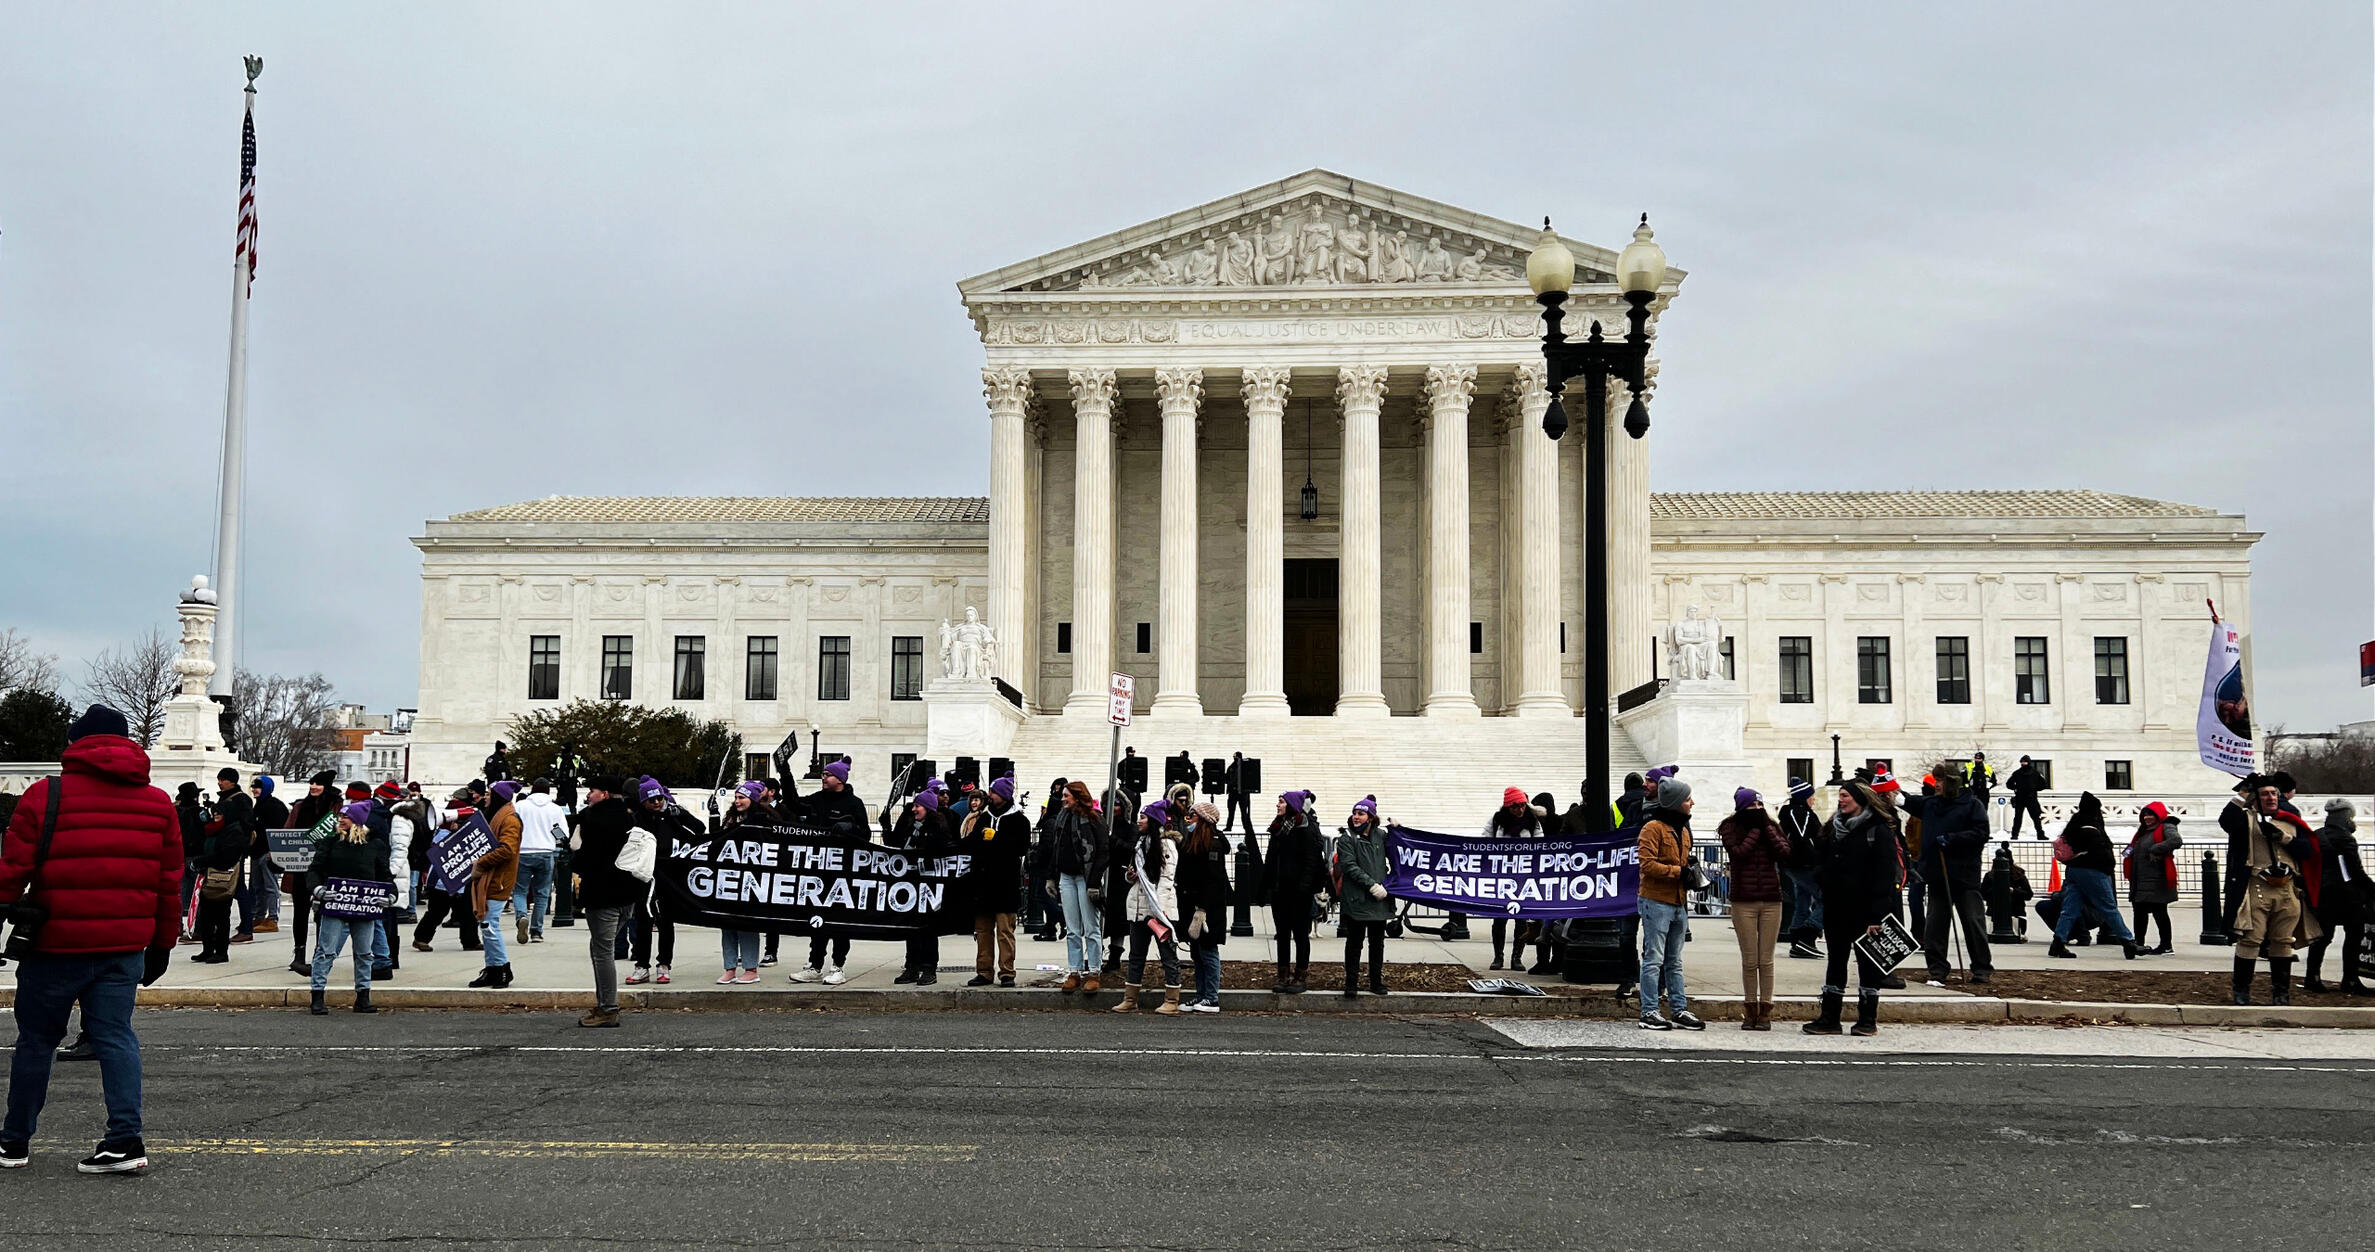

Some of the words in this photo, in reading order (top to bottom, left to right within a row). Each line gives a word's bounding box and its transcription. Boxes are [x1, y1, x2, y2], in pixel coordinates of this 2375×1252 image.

[1190, 323, 1252, 339] EQUAL
[1255, 322, 1328, 338] JUSTICE
[1336, 321, 1399, 336] UNDER
[1405, 320, 1442, 335] LAW
[442, 833, 488, 874] PRO-LIFE
[447, 843, 462, 859] AM
[462, 828, 481, 844] THE
[670, 838, 712, 861] WE
[716, 840, 779, 867] ARE
[787, 845, 844, 870] THE
[852, 849, 972, 877] PRO-LIFE
[1462, 841, 1573, 852] STUDENTSFORLIFE.ORG
[448, 843, 492, 879] GENERATION
[1396, 845, 1431, 870] WE
[1435, 853, 1482, 873] ARE
[1488, 854, 1533, 874] THE
[1539, 845, 1640, 873] PRO-LIFE
[339, 885, 359, 893] AM
[363, 887, 386, 896] THE
[687, 867, 944, 913] GENERATION
[1413, 872, 1618, 901] GENERATION
[324, 902, 384, 913] GENERATION
[1879, 937, 1898, 955] ANTI-
[1881, 922, 1912, 956] ABORTION
